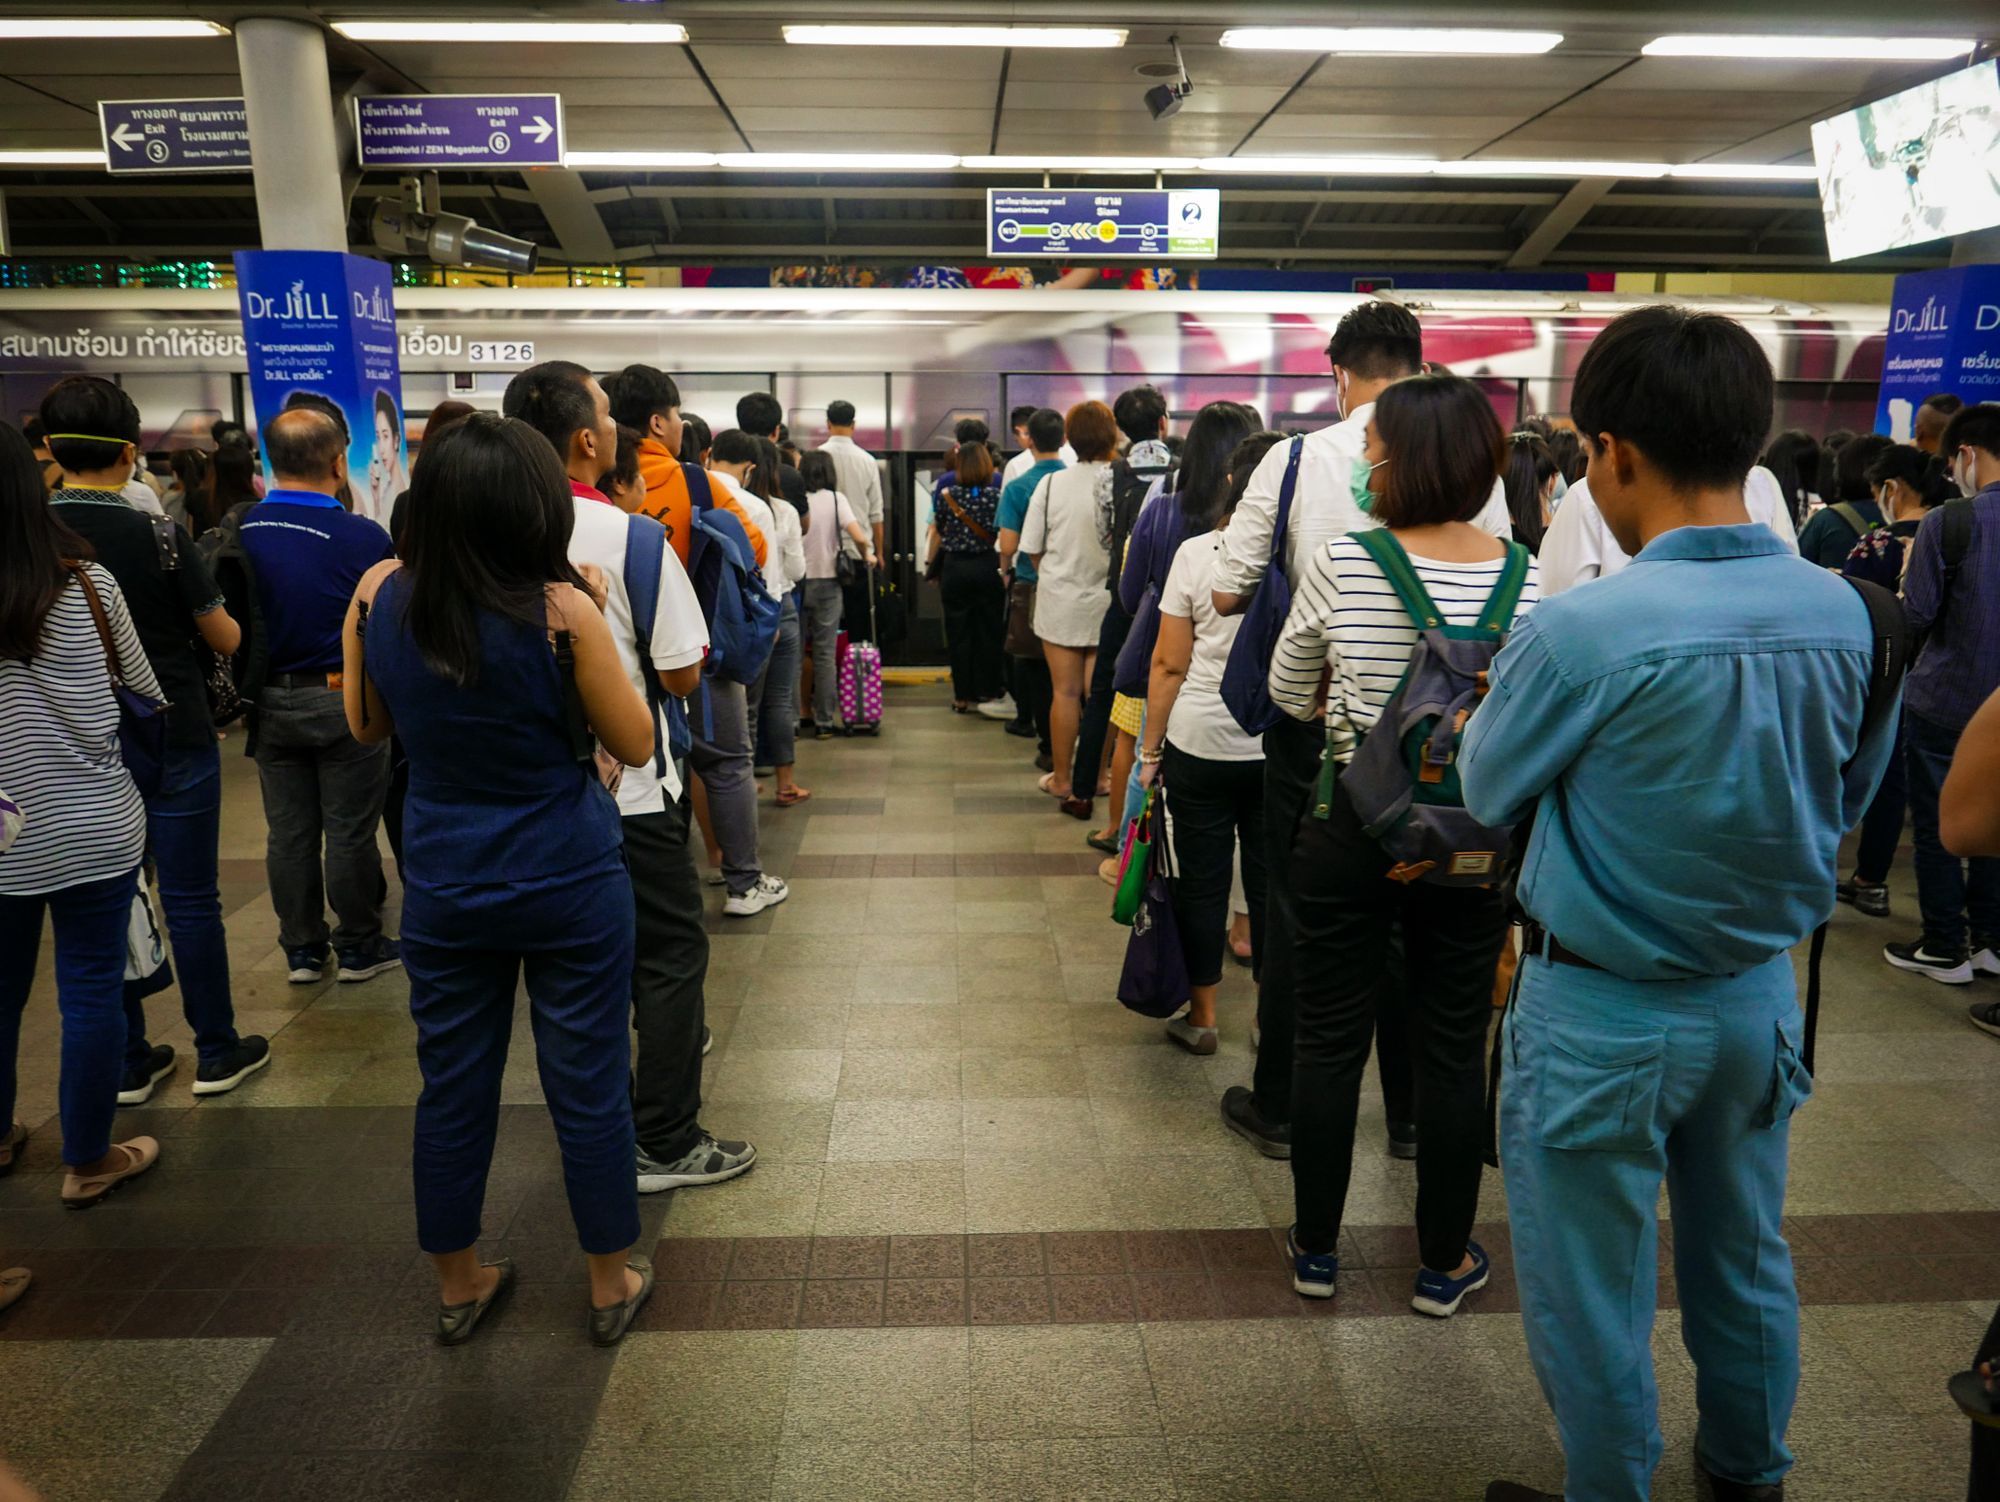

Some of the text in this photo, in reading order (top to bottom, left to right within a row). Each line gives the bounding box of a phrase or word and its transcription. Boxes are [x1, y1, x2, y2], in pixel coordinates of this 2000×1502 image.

[131, 108, 177, 119] ทางออก
[476, 106, 519, 116] ทางออก
[144, 124, 166, 134] Exit
[495, 136, 505, 150] 6
[153, 143, 163, 159] 3
[426, 145, 444, 155] ZEN
[1095, 196, 1122, 206] สยาม
[1097, 207, 1120, 217] Siam
[471, 344, 532, 360] 3126
